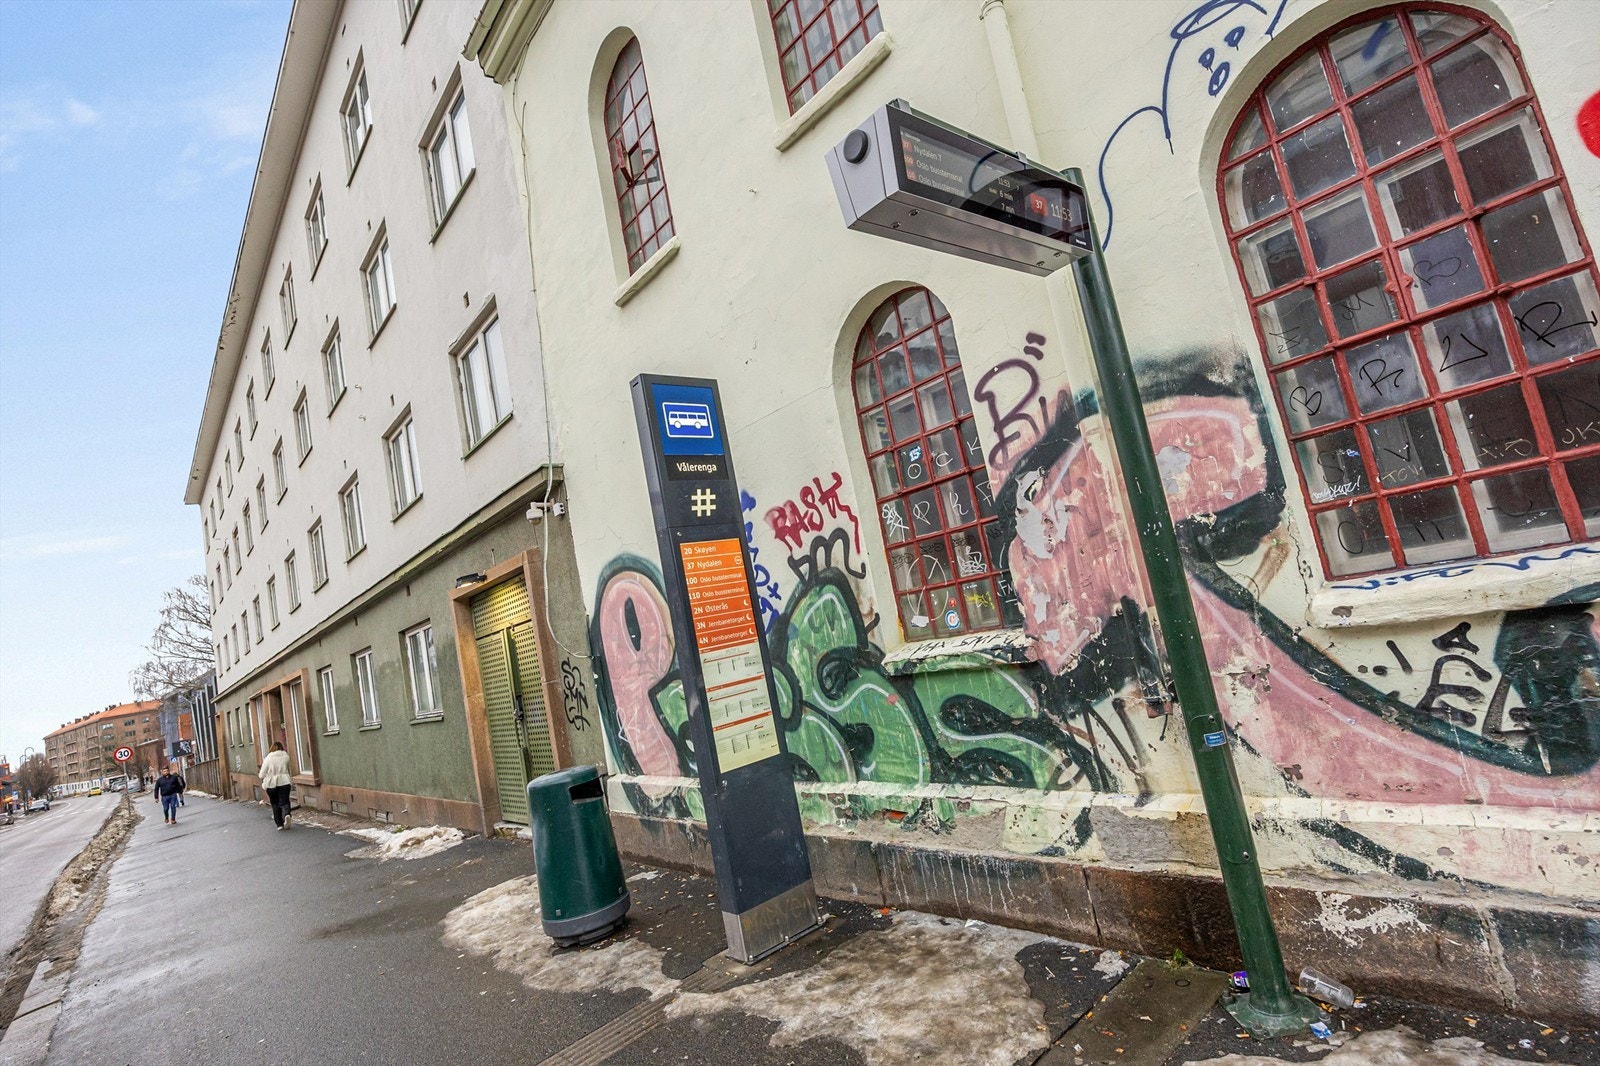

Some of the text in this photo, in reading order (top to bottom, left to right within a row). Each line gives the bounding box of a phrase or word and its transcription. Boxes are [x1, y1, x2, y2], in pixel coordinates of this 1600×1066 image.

[914, 145, 938, 160] Nydalen
[916, 160, 929, 171] Oslo
[919, 175, 932, 186] Oslo
[1050, 203, 1072, 222] 11:53
[676, 462, 717, 473] Vålerenga
[694, 546, 716, 554] Skøyen
[687, 560, 722, 570] 37 Nydalen
[712, 573, 742, 581] bussterminal
[689, 592, 700, 600] 110
[715, 587, 744, 596] bussterminal
[705, 603, 728, 612] Østerås
[708, 616, 745, 628] Jernbanetorget
[699, 630, 748, 644] 4N Jernbanetorget
[118, 750, 129, 758] 30
